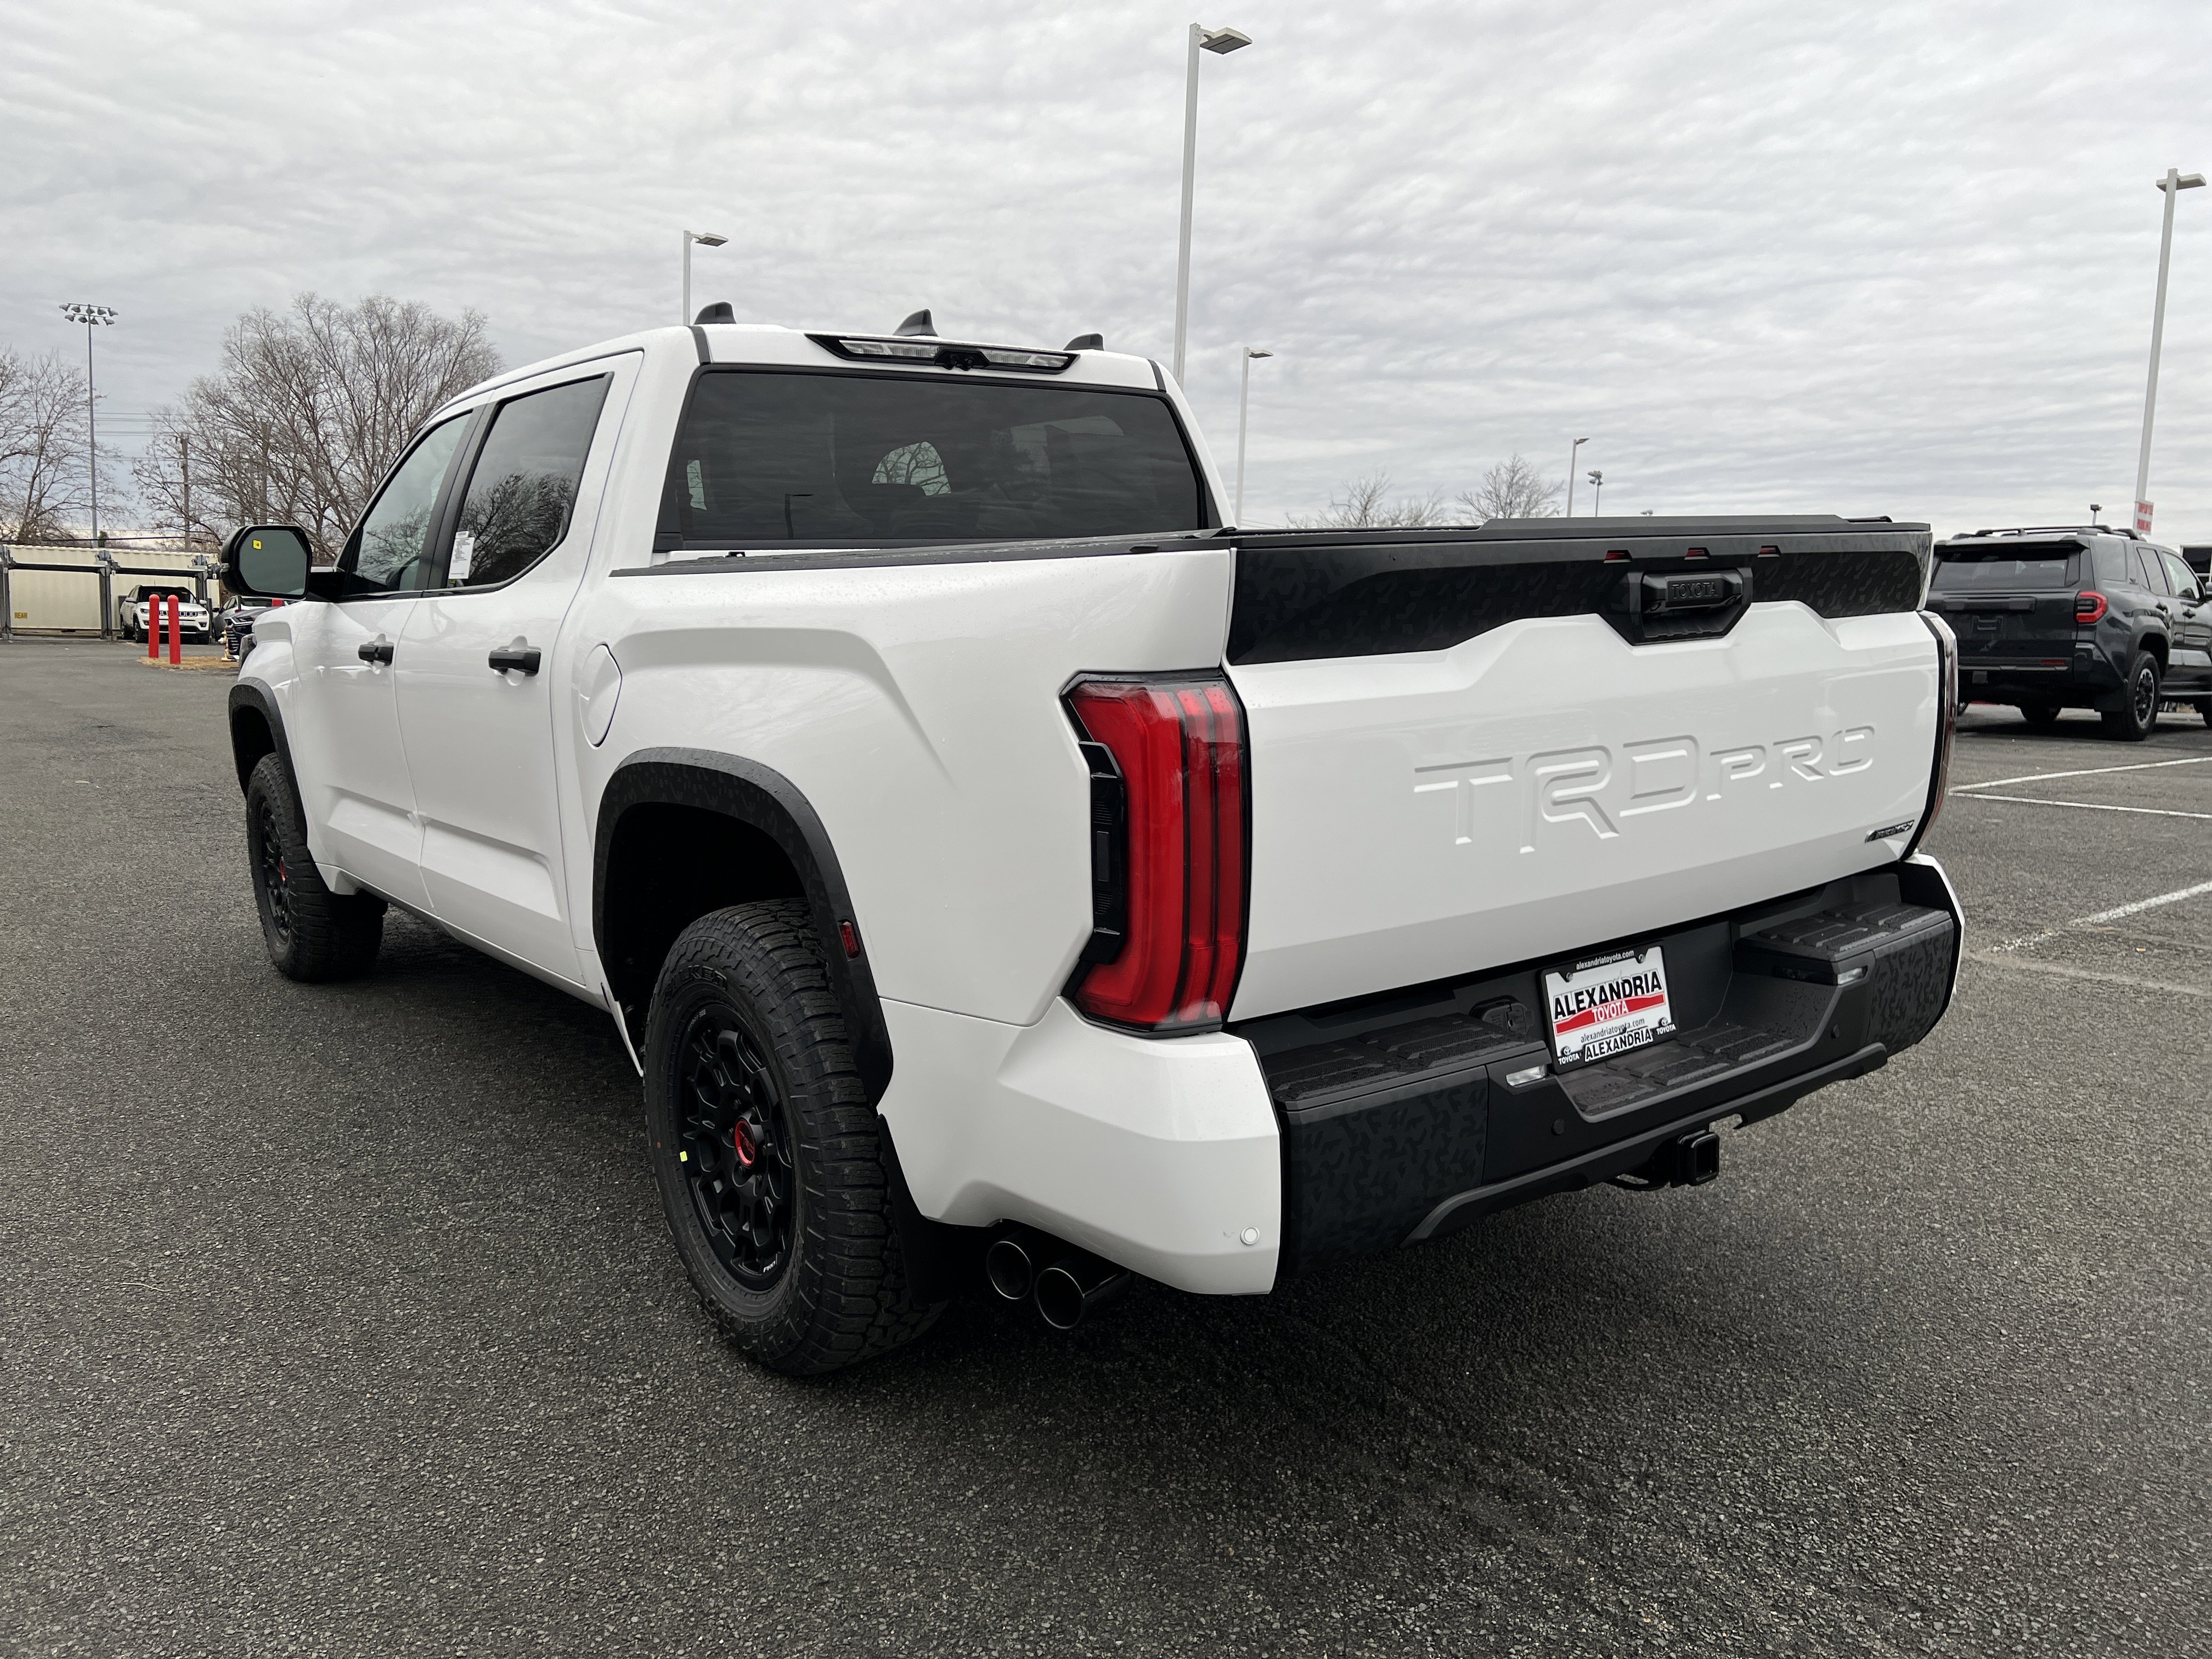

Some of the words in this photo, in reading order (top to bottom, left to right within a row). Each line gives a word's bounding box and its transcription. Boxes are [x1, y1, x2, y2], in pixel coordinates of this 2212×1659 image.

[1671, 582, 1718, 599] TOYOTA
[1413, 733, 1701, 854] TRD
[1706, 724, 1876, 802] PRO
[1576, 950, 1634, 970] alexandriatoyota.com
[1554, 970, 1662, 1020] ALEXANDRIA
[1592, 1000, 1629, 1023] TOYOTA
[1581, 1018, 1645, 1042] alexandriatoyota.com
[1656, 1023, 1676, 1035] TOYOTA
[1585, 1029, 1653, 1062] ALEXANDRIA
[1558, 1052, 1579, 1065] TOYOTA
